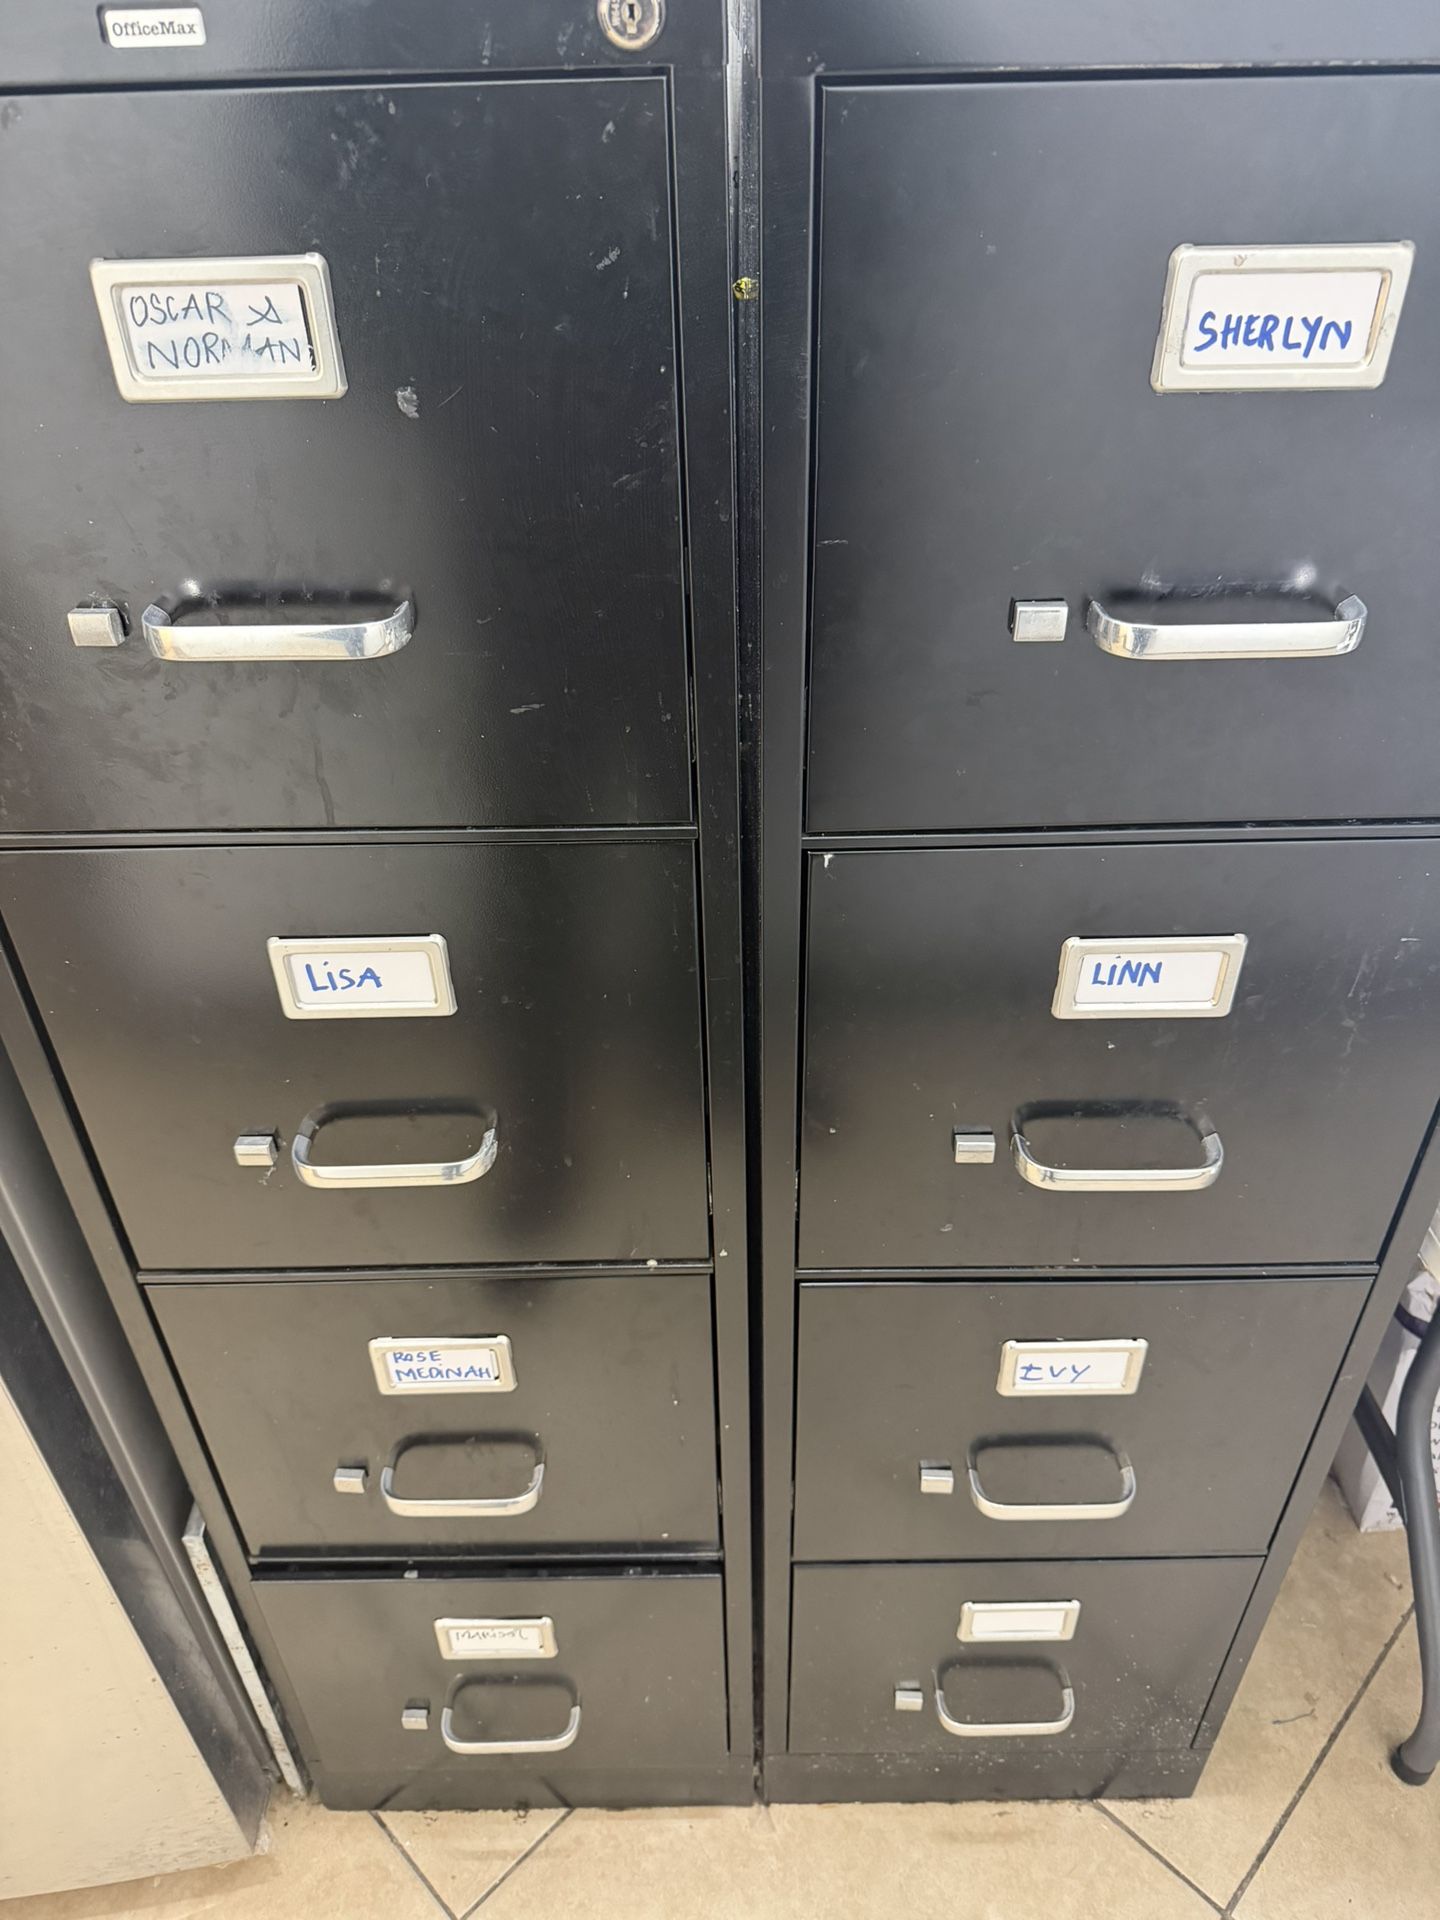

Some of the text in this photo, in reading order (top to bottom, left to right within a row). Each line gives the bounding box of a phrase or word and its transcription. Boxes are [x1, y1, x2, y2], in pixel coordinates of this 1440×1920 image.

[112, 21, 196, 36] OfficeMax
[130, 292, 232, 327] OSCAR
[1194, 311, 1352, 358] SHERLYN
[393, 1350, 441, 1363] ROSE
